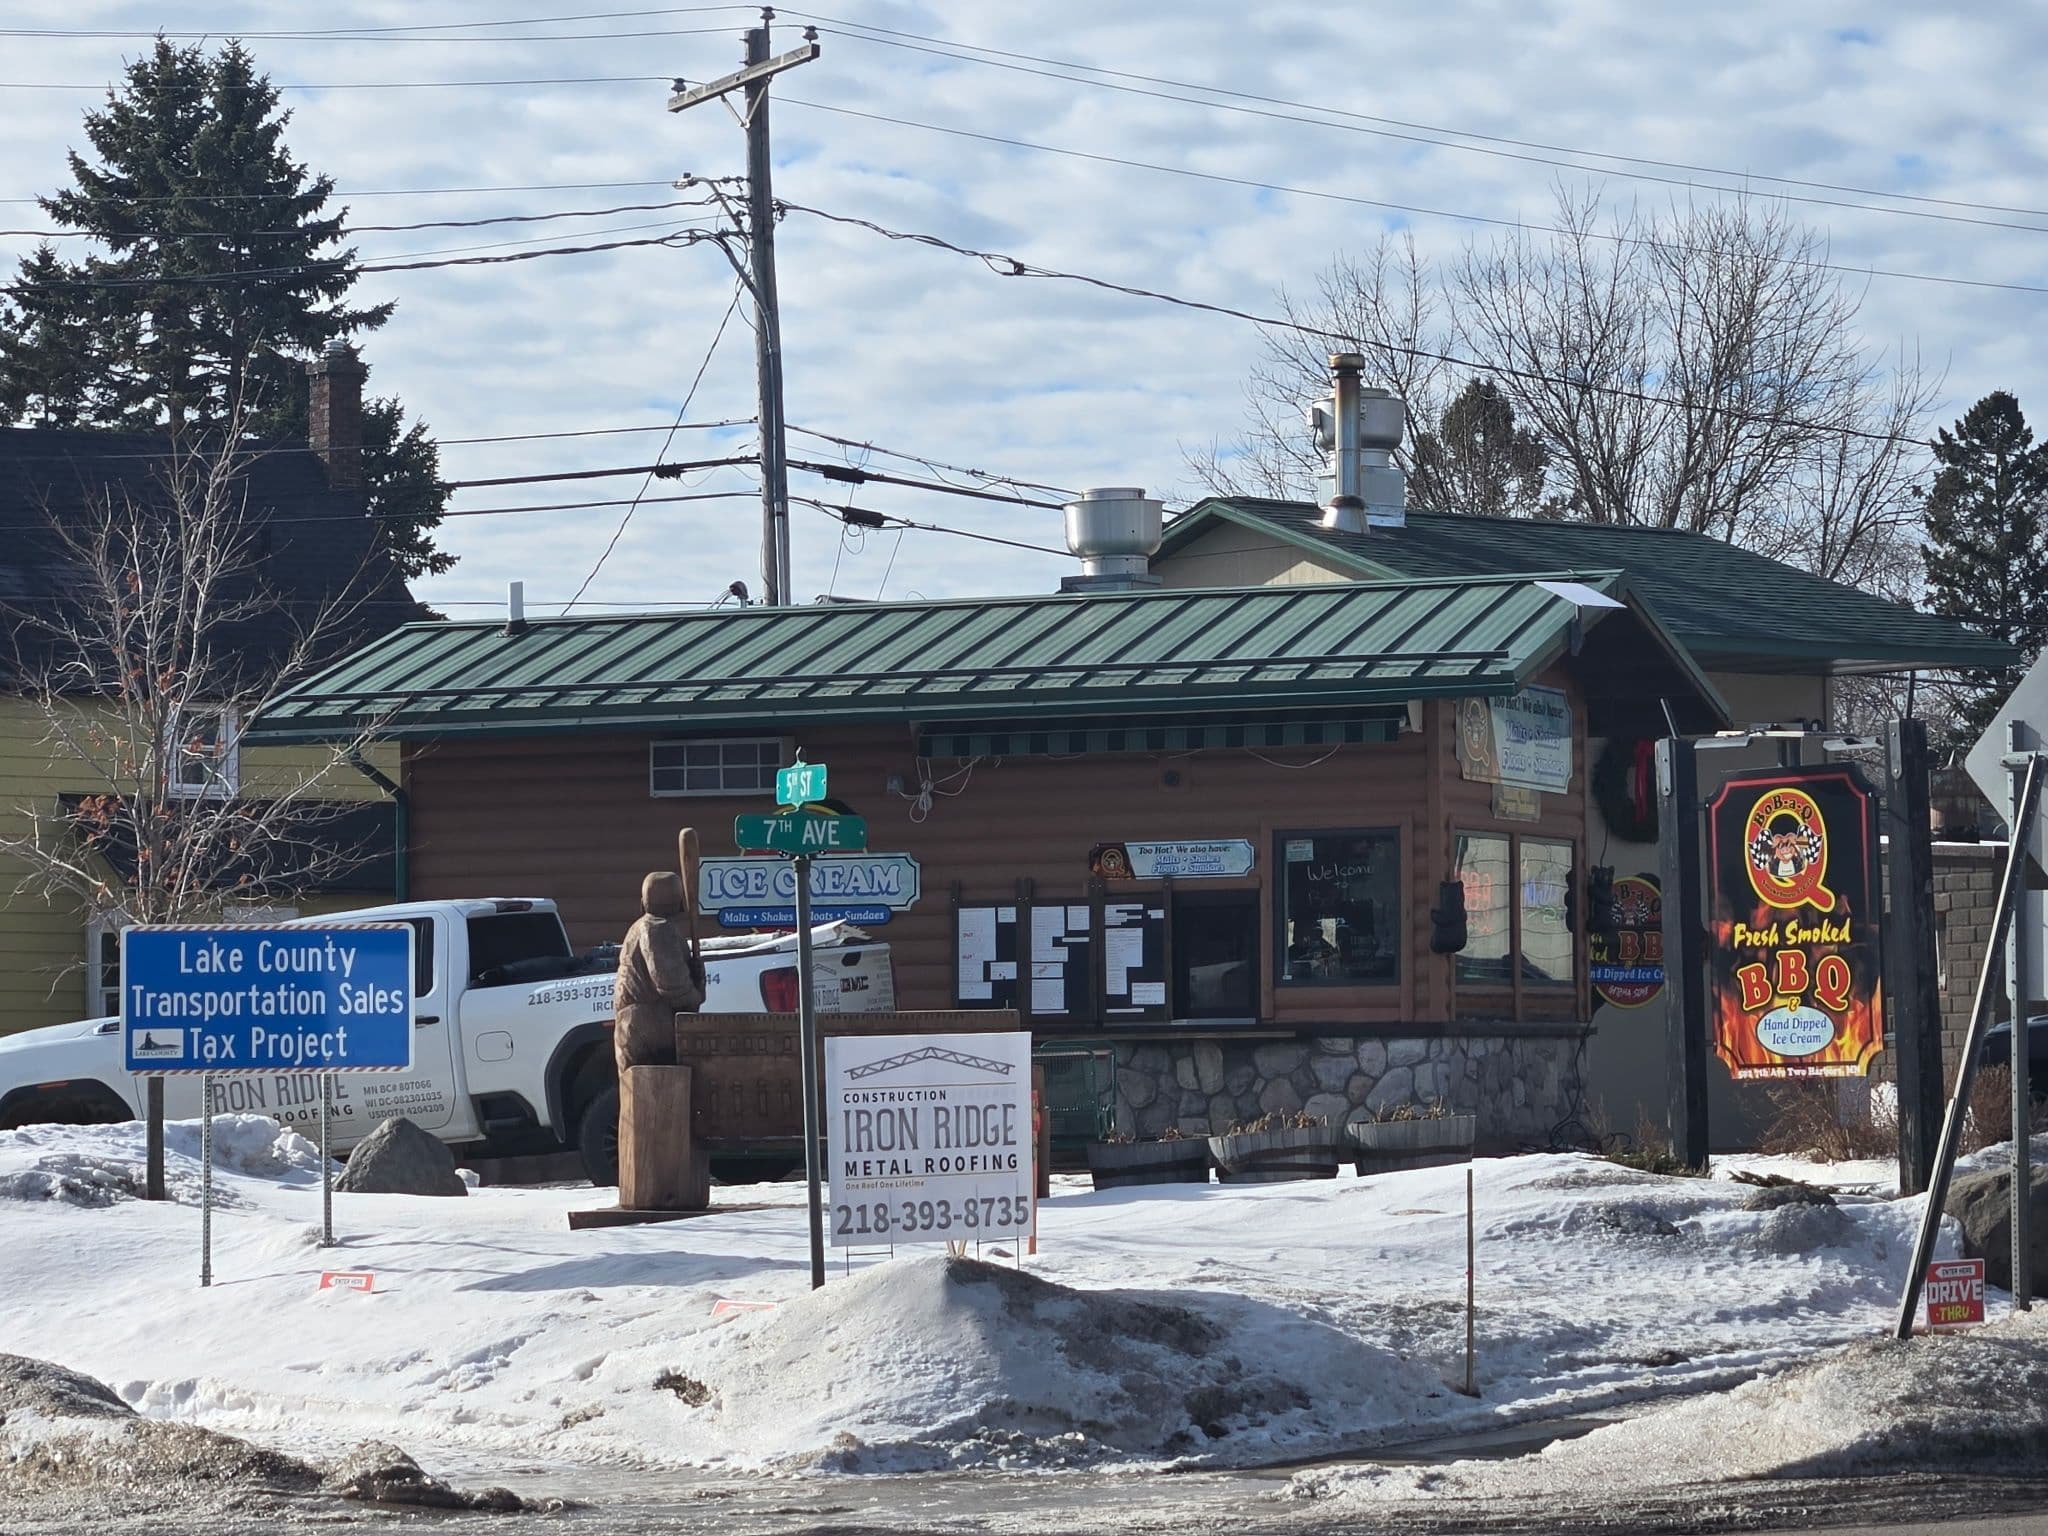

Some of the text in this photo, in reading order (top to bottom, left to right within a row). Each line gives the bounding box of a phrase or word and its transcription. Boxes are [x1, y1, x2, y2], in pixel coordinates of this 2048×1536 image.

[800, 770, 813, 797] ST
[763, 819, 840, 845] 7TH AVE
[1138, 847, 1152, 855] Too
[1155, 845, 1173, 854] Hot?
[1176, 845, 1188, 853] We
[1190, 845, 1206, 853] also
[708, 867, 768, 899] ICE
[724, 910, 885, 923] Malts Shakes loats Sundaes
[1618, 930, 1663, 960] BB
[1734, 917, 1851, 948] Fresh Smoked
[180, 940, 357, 978] Lake County
[1603, 968, 1635, 981] Dipped
[1638, 967, 1652, 979] Ice
[1736, 949, 1851, 1011] BBQ
[132, 983, 404, 1021] Transportation Sales
[528, 984, 615, 1006] 218-393-8735
[1764, 1017, 1827, 1032] Hand Dipped
[190, 1026, 347, 1065] Tax Project
[1772, 1032, 1822, 1045] Ice Cream
[1787, 1067, 1807, 1076] Two
[212, 1077, 266, 1114] RON
[843, 1090, 947, 1103] CONSTRUCTION
[273, 1105, 353, 1123] ROOFNG
[843, 1103, 1017, 1153] IRON RIDGE
[845, 1153, 1018, 1177] METAL ROOFING
[845, 1179, 925, 1190] One Roof One Lifetime
[836, 1195, 1029, 1235] 218-393-8735
[1942, 1266, 1973, 1276] ENTER HERE
[1928, 1279, 1983, 1305] DRIVE
[1939, 1305, 1970, 1321] THRU
